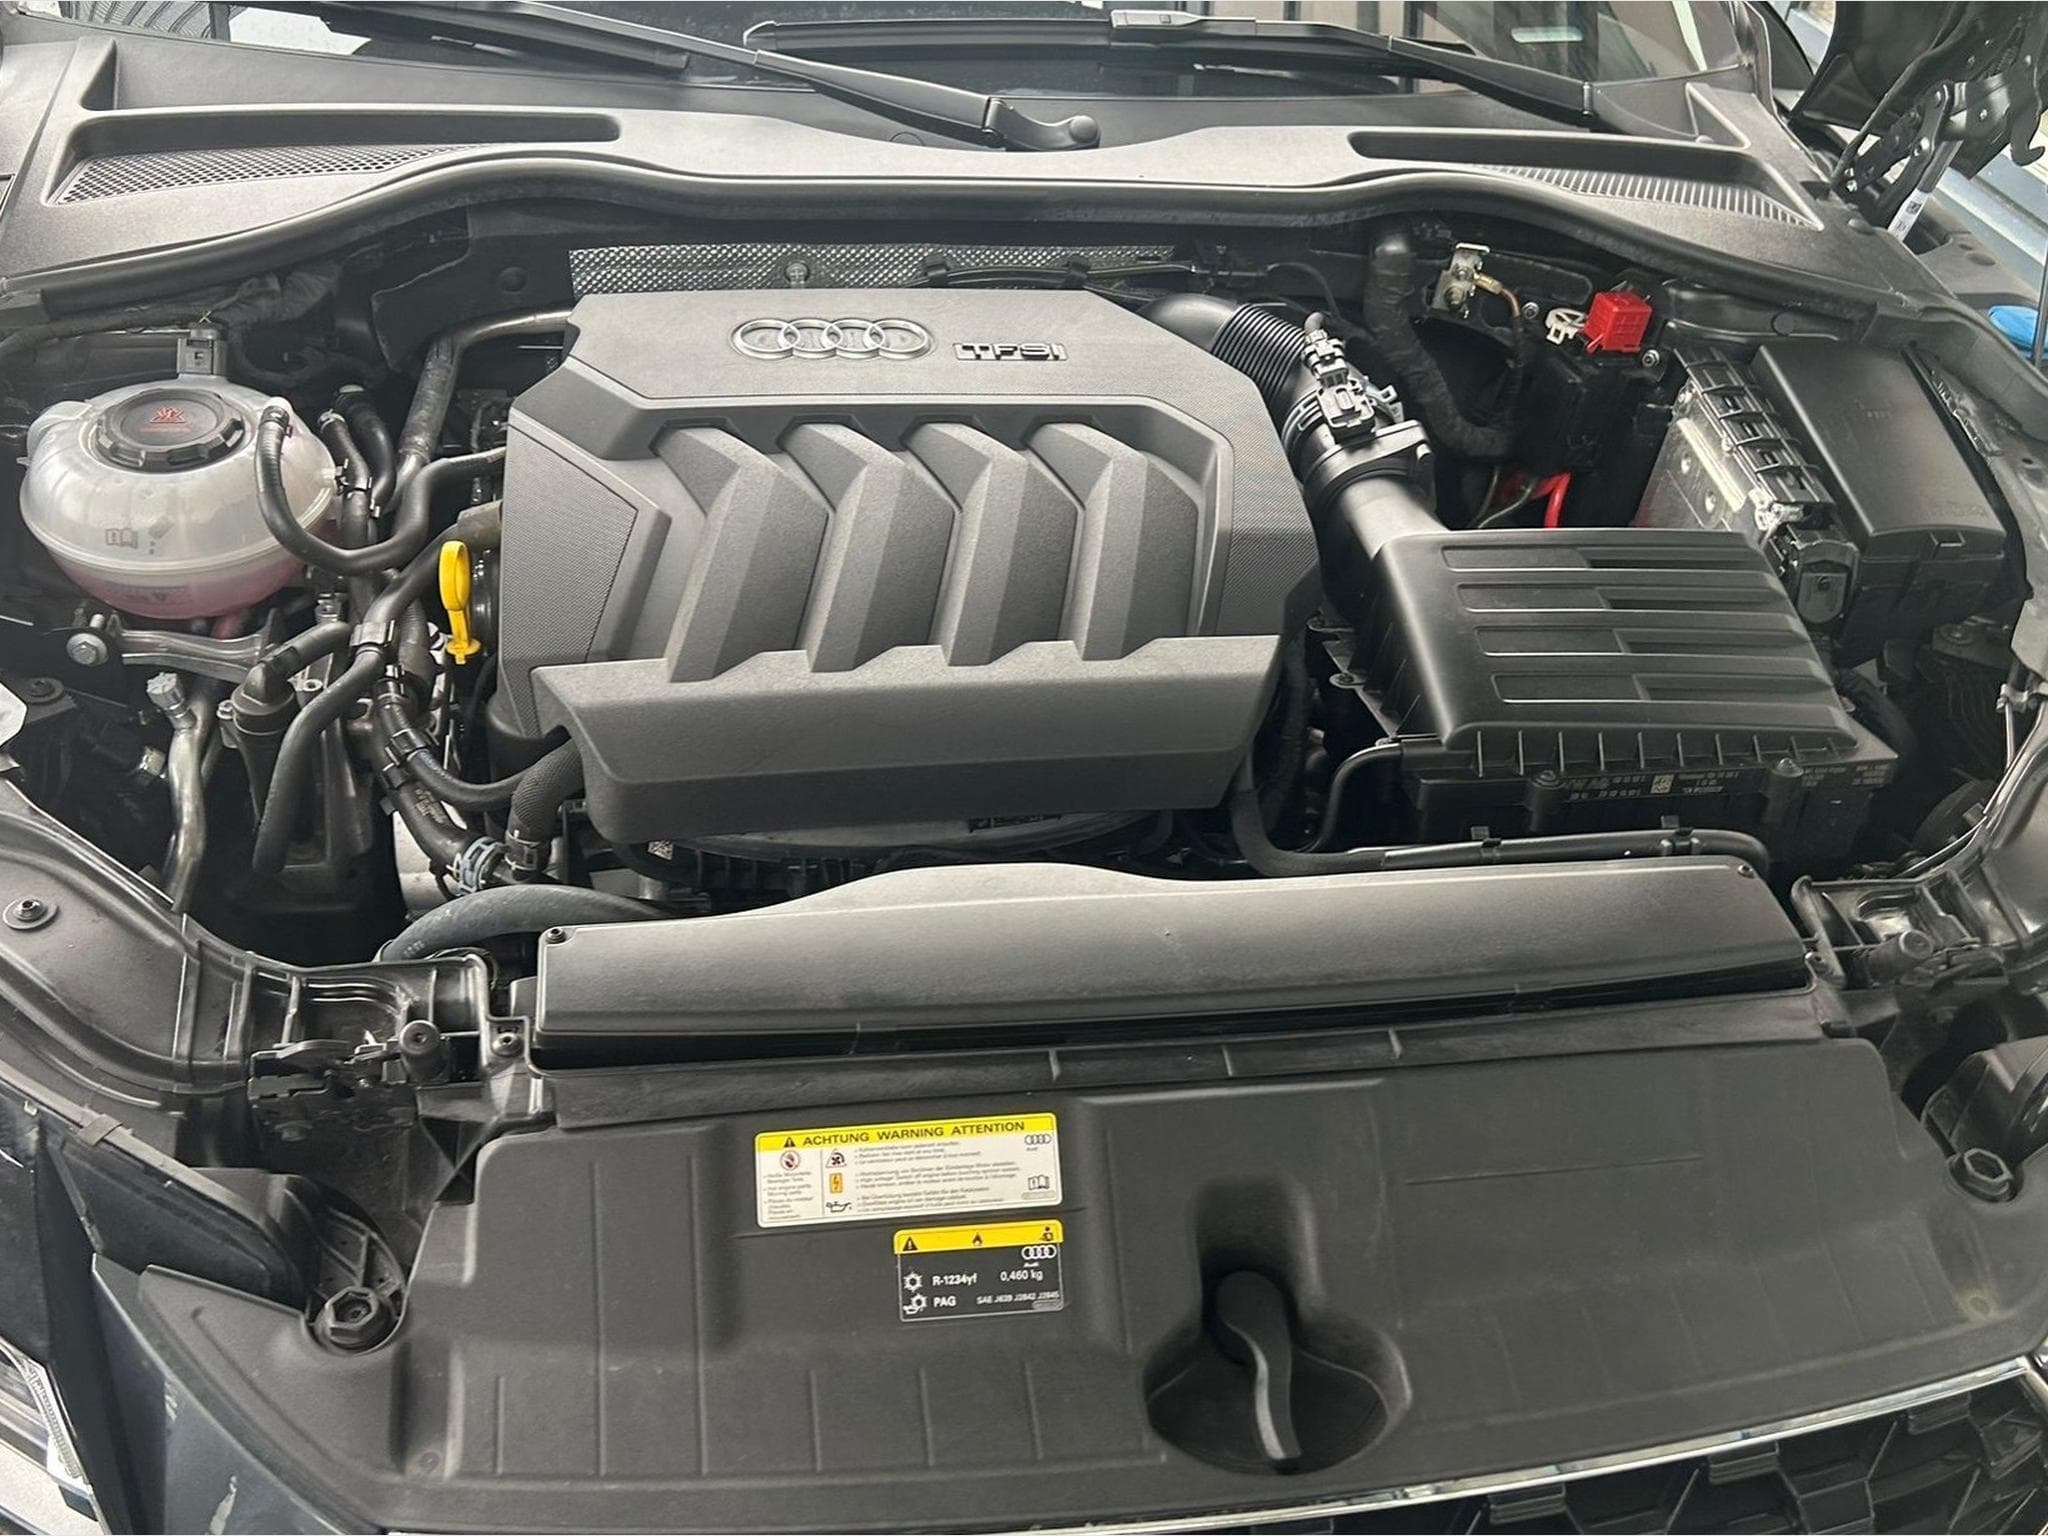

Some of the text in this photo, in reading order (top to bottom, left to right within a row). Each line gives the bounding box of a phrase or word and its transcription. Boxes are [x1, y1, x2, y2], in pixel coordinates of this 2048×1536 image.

[802, 1121, 1025, 1146] ACHTUNG WARNING ATTENTION
[932, 1272, 977, 1286] R-1234yf
[1030, 1269, 1043, 1281] kg
[933, 1295, 956, 1308] PAG
